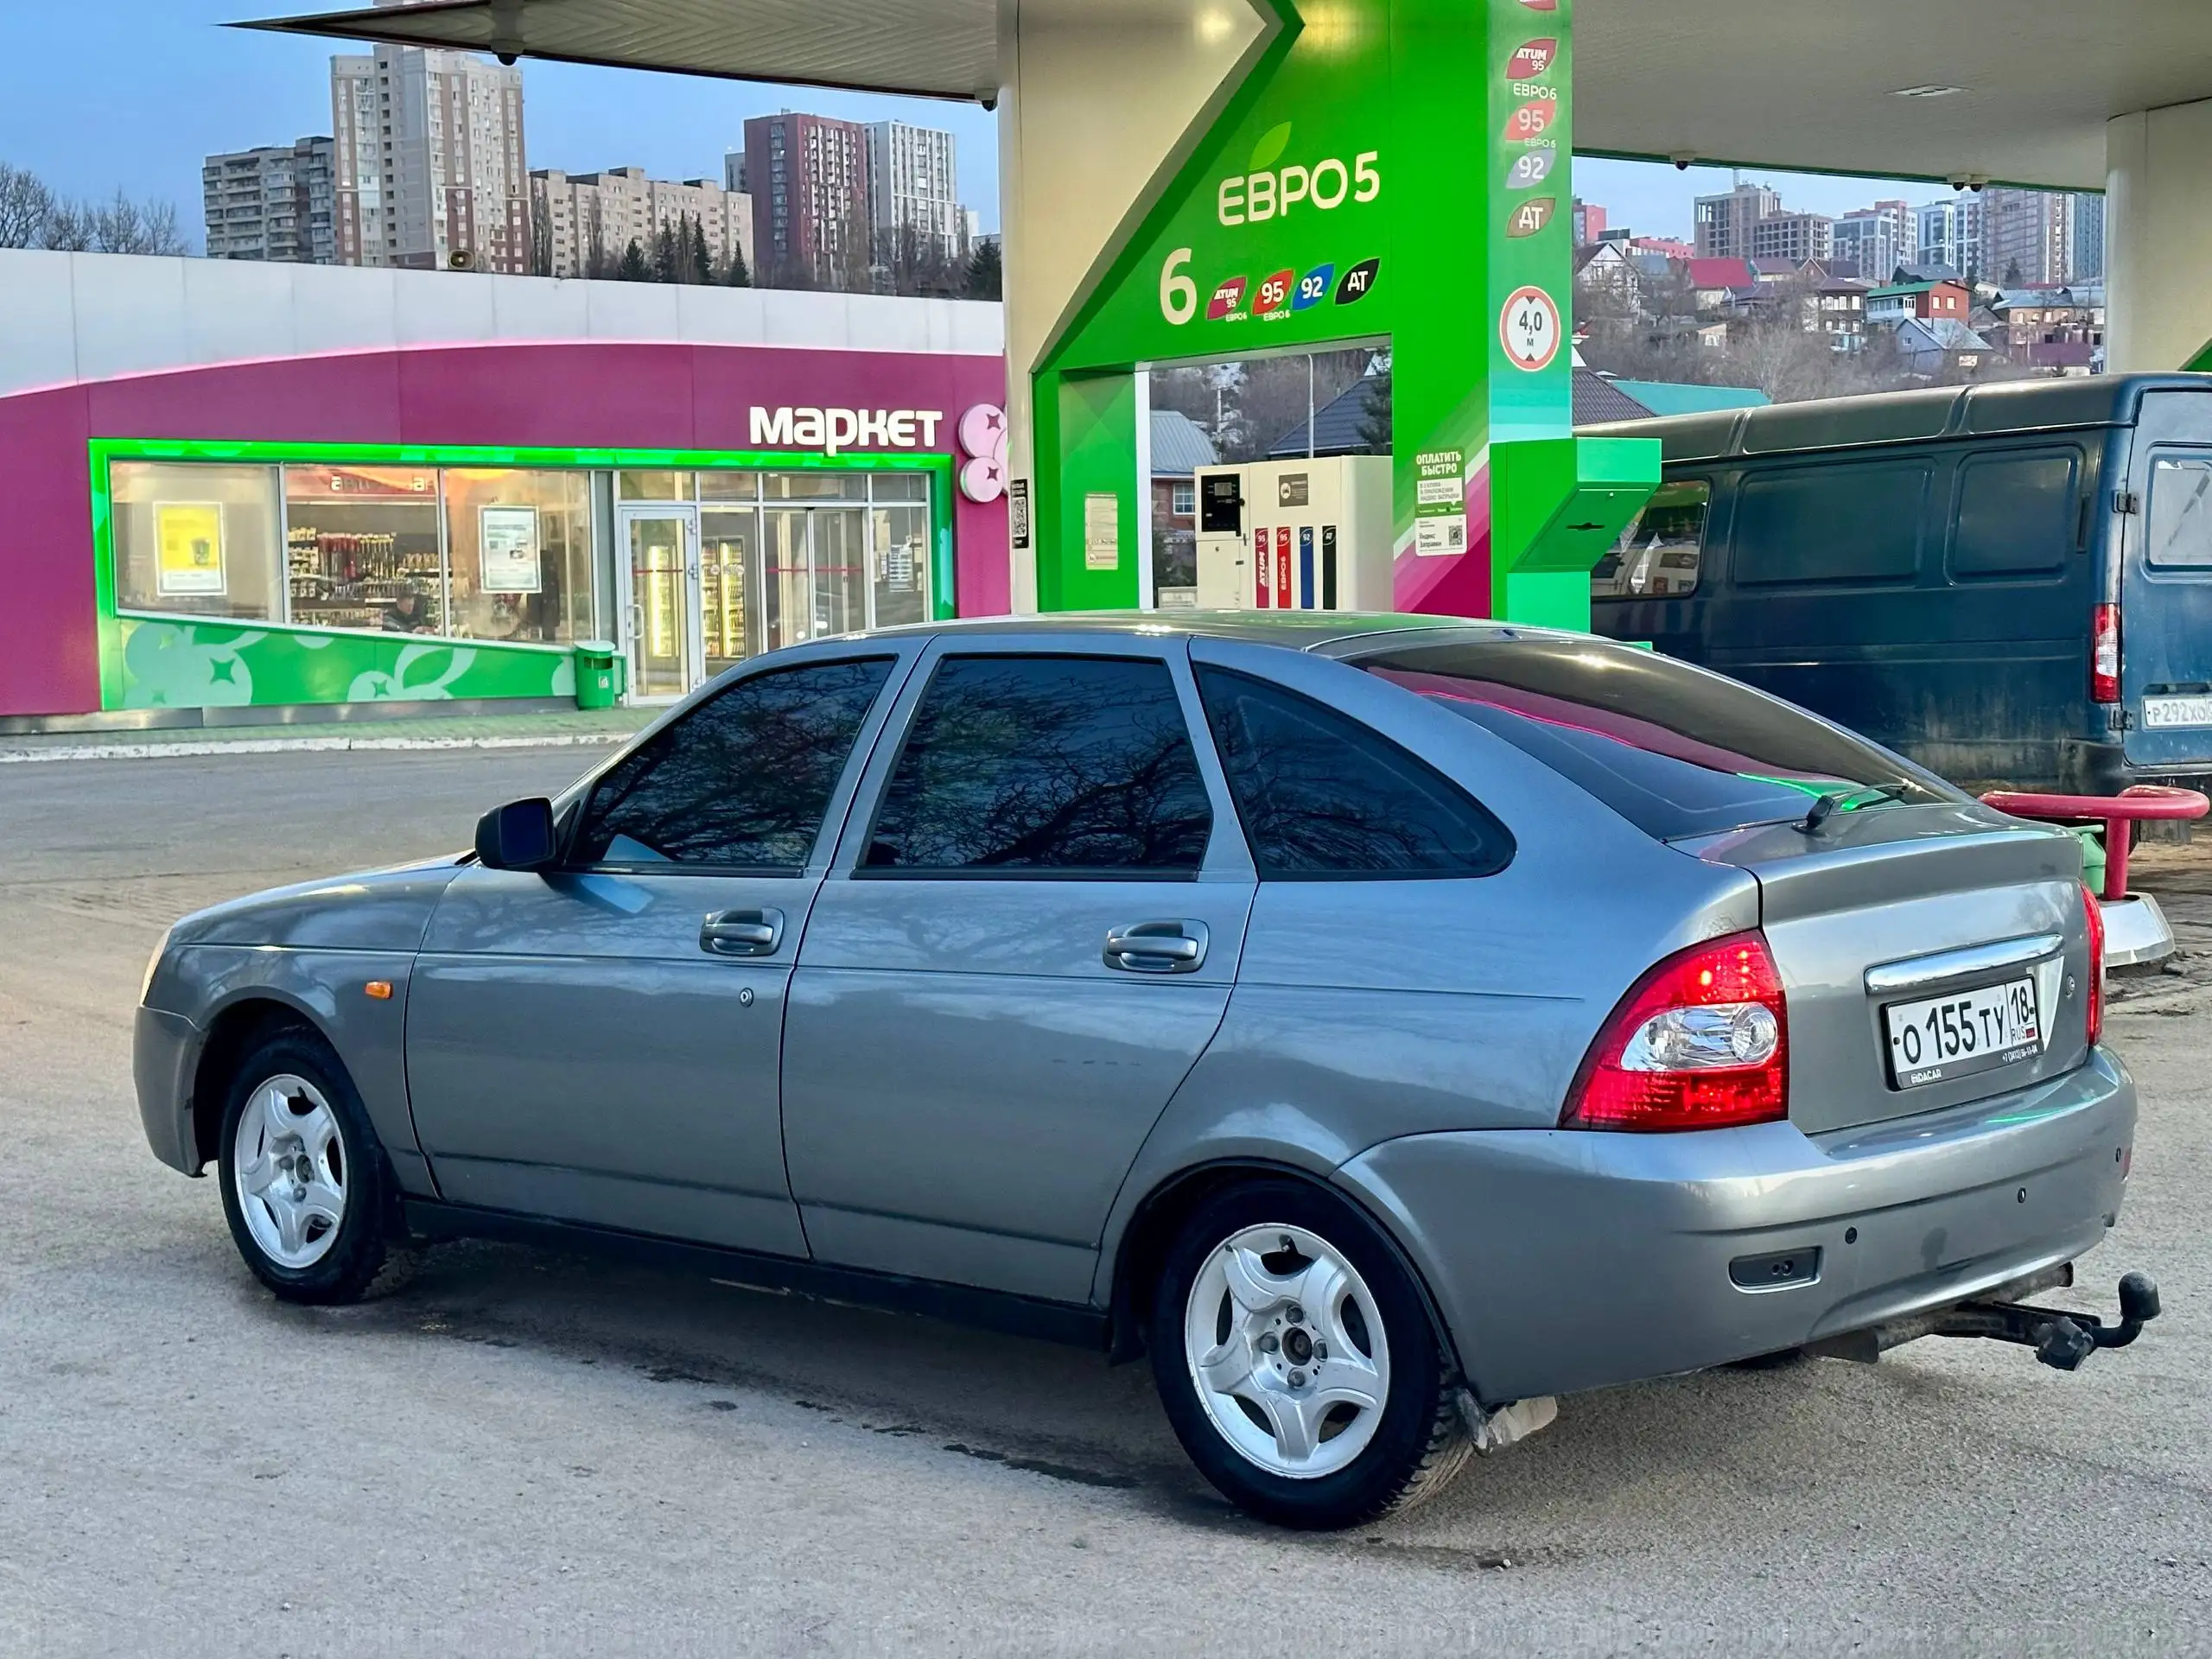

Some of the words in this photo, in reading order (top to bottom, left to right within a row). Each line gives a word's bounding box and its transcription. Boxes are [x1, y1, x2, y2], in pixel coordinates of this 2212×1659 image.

[1516, 48, 1548, 60] ATUM
[1531, 60, 1545, 71] 95
[1518, 108, 1545, 131] 95
[1518, 156, 1545, 180] 92
[1160, 247, 1198, 326] 6
[1214, 287, 1239, 301] ATUM
[1262, 281, 1285, 304] 95
[1300, 276, 1324, 299] 92
[1226, 298, 1236, 308] 95
[1519, 310, 1543, 335] 4,0
[1416, 451, 1462, 465] ОПЛАТИТЬ
[1421, 462, 1458, 476] БЫСТРО
[1258, 534, 1266, 543] 95
[2011, 986, 2029, 1025] 18
[2012, 1025, 2025, 1040] RUS
